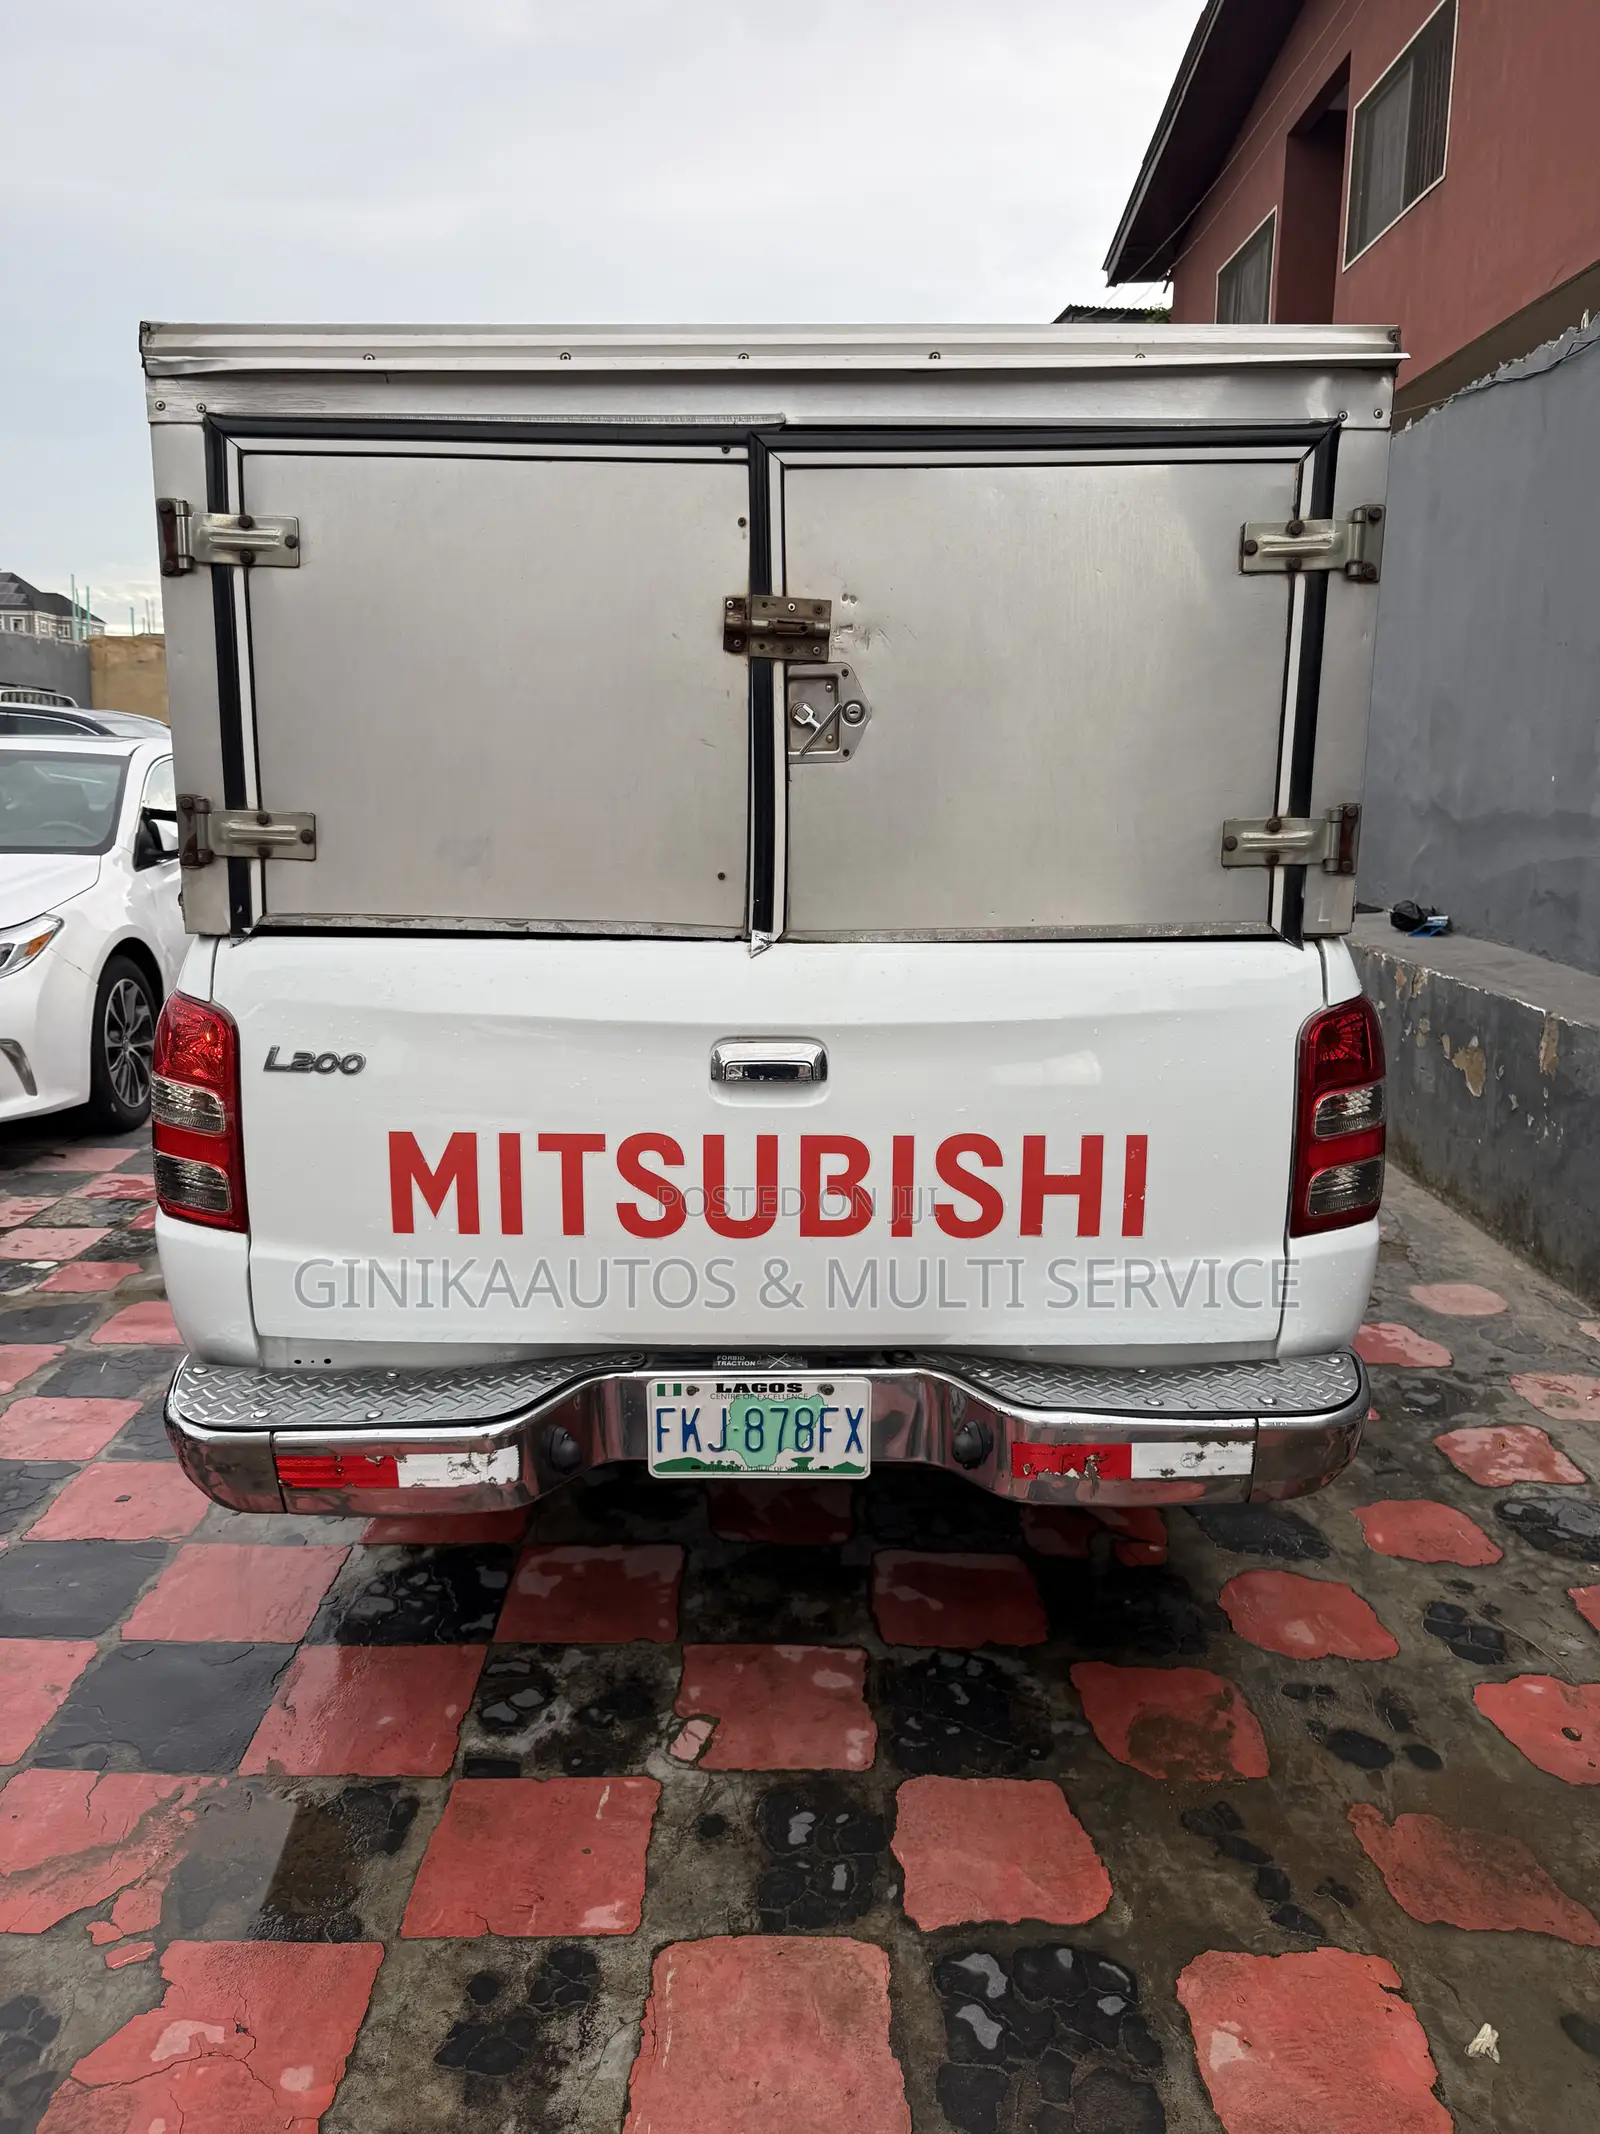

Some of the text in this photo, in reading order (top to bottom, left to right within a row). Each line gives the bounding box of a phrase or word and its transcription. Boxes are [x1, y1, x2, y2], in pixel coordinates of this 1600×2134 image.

[263, 1044, 367, 1075] L200
[388, 1131, 1148, 1239] MITSUBISHI
[715, 1383, 803, 1394] LAGOS
